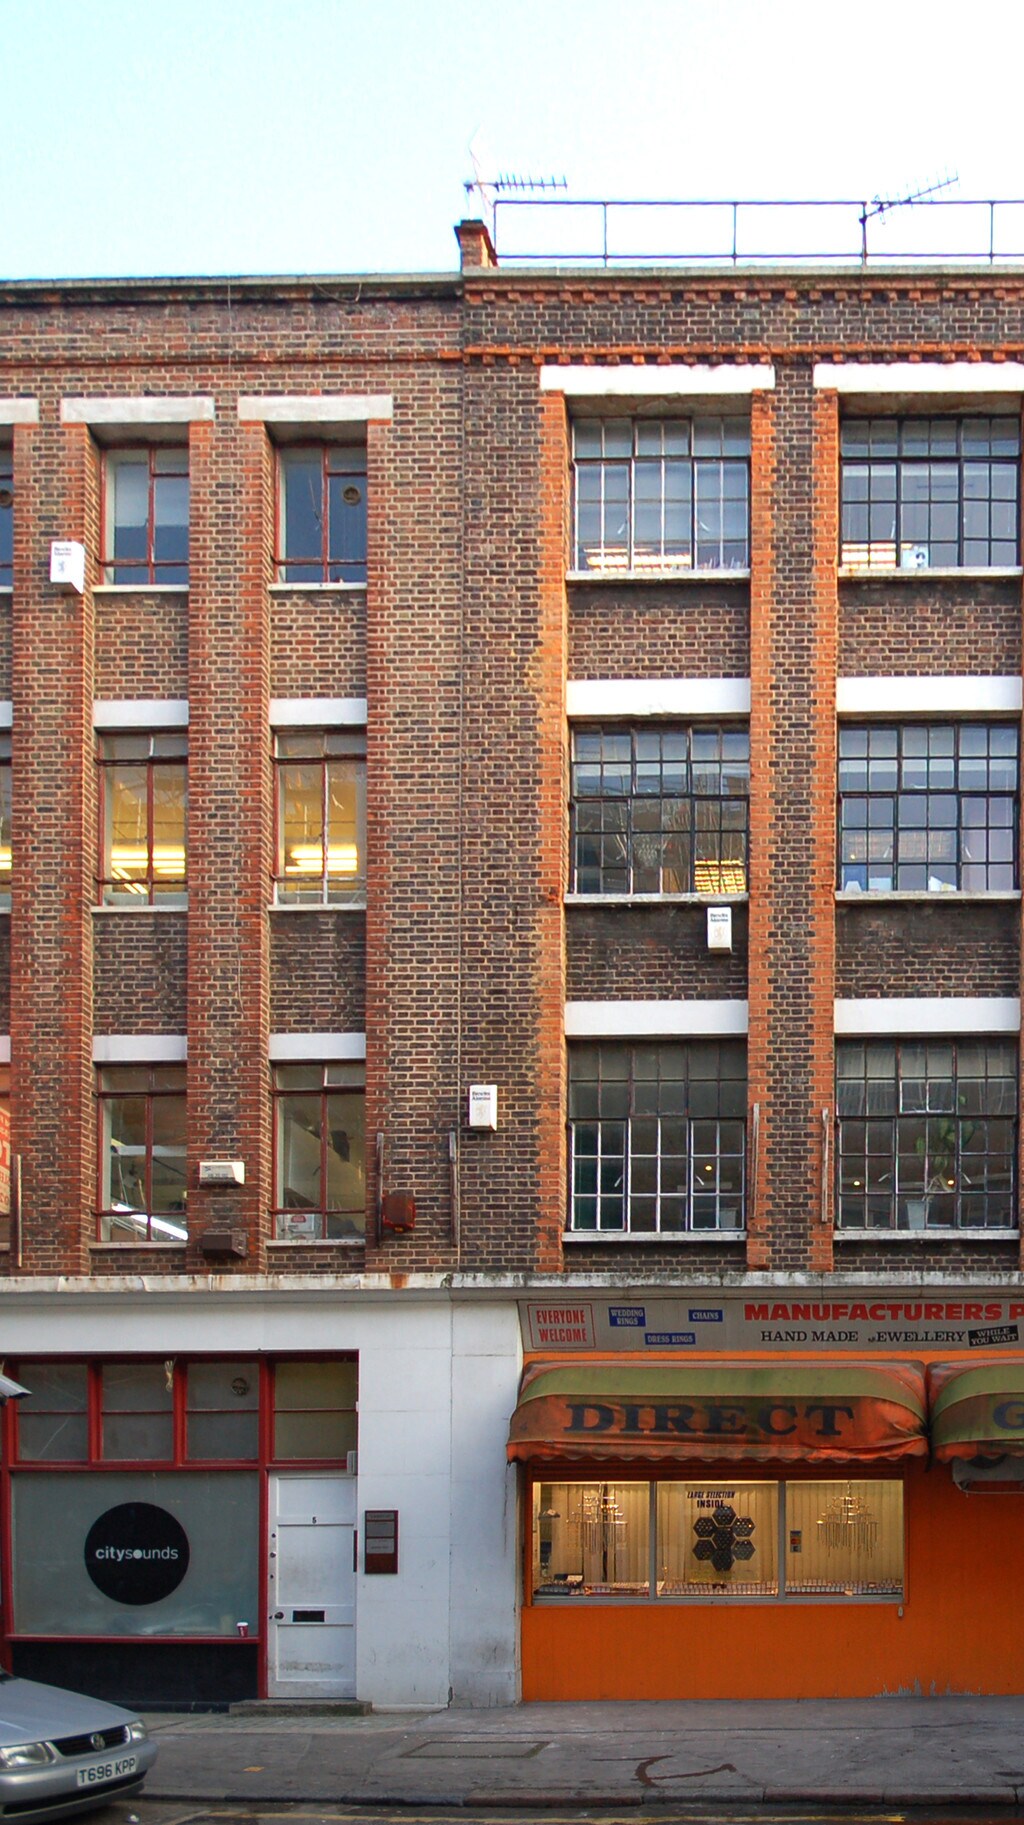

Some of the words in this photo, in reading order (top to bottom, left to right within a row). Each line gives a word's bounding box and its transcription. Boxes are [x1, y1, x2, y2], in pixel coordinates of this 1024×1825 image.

[536, 1310, 585, 1324] EVERYONE
[610, 1309, 644, 1317] WEDDING
[692, 1311, 719, 1320] CHAINS
[744, 1303, 1002, 1321] MANUFACTURERS
[617, 1317, 639, 1325] RINGS
[539, 1328, 587, 1342] WELCOME
[761, 1331, 807, 1342] HAND
[811, 1331, 858, 1342] MADE
[976, 1327, 1010, 1337] WHILE
[647, 1335, 669, 1343] DRESS
[672, 1335, 693, 1343] RINGS
[971, 1336, 990, 1345] YOU
[992, 1333, 1017, 1343] WAIT
[564, 1403, 856, 1437] DIRECT
[95, 1546, 179, 1562] citysounds
[79, 1764, 112, 1783] T696
[115, 1757, 136, 1776] KPP
